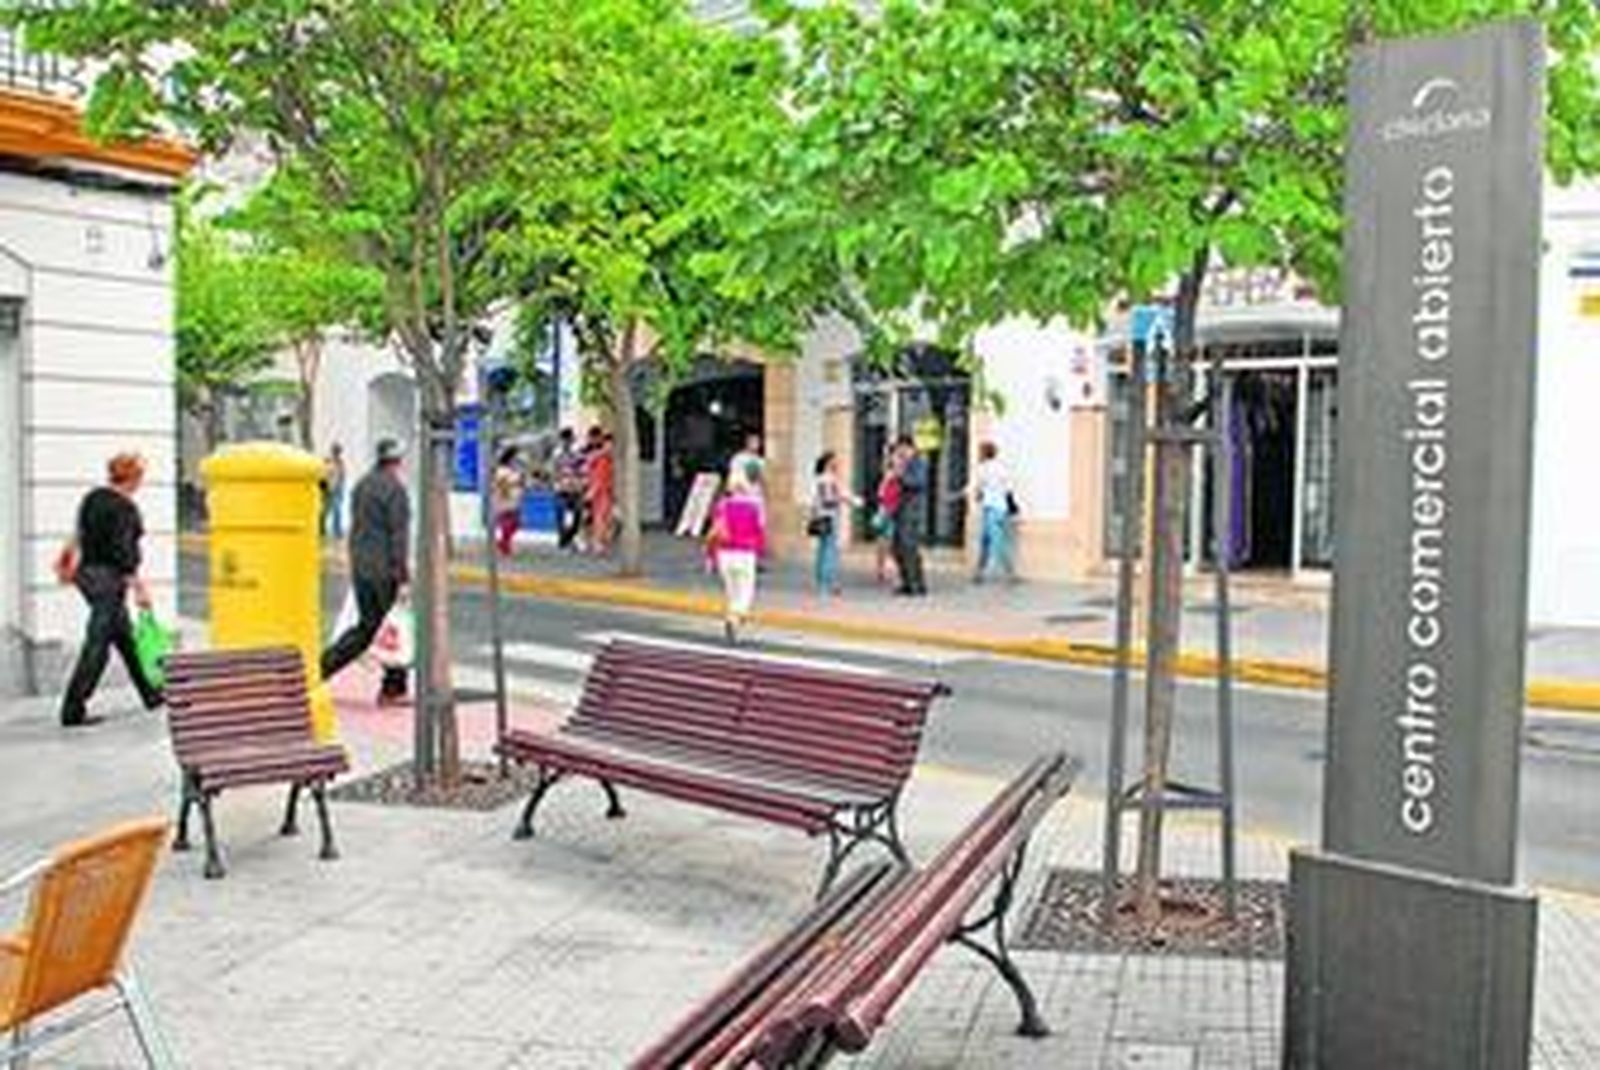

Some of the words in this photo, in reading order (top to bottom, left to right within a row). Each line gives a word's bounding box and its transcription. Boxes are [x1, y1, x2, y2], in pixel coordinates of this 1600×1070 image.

[1412, 165, 1453, 360] abierto
[1402, 380, 1447, 647] comercial
[1396, 664, 1438, 832] centro
